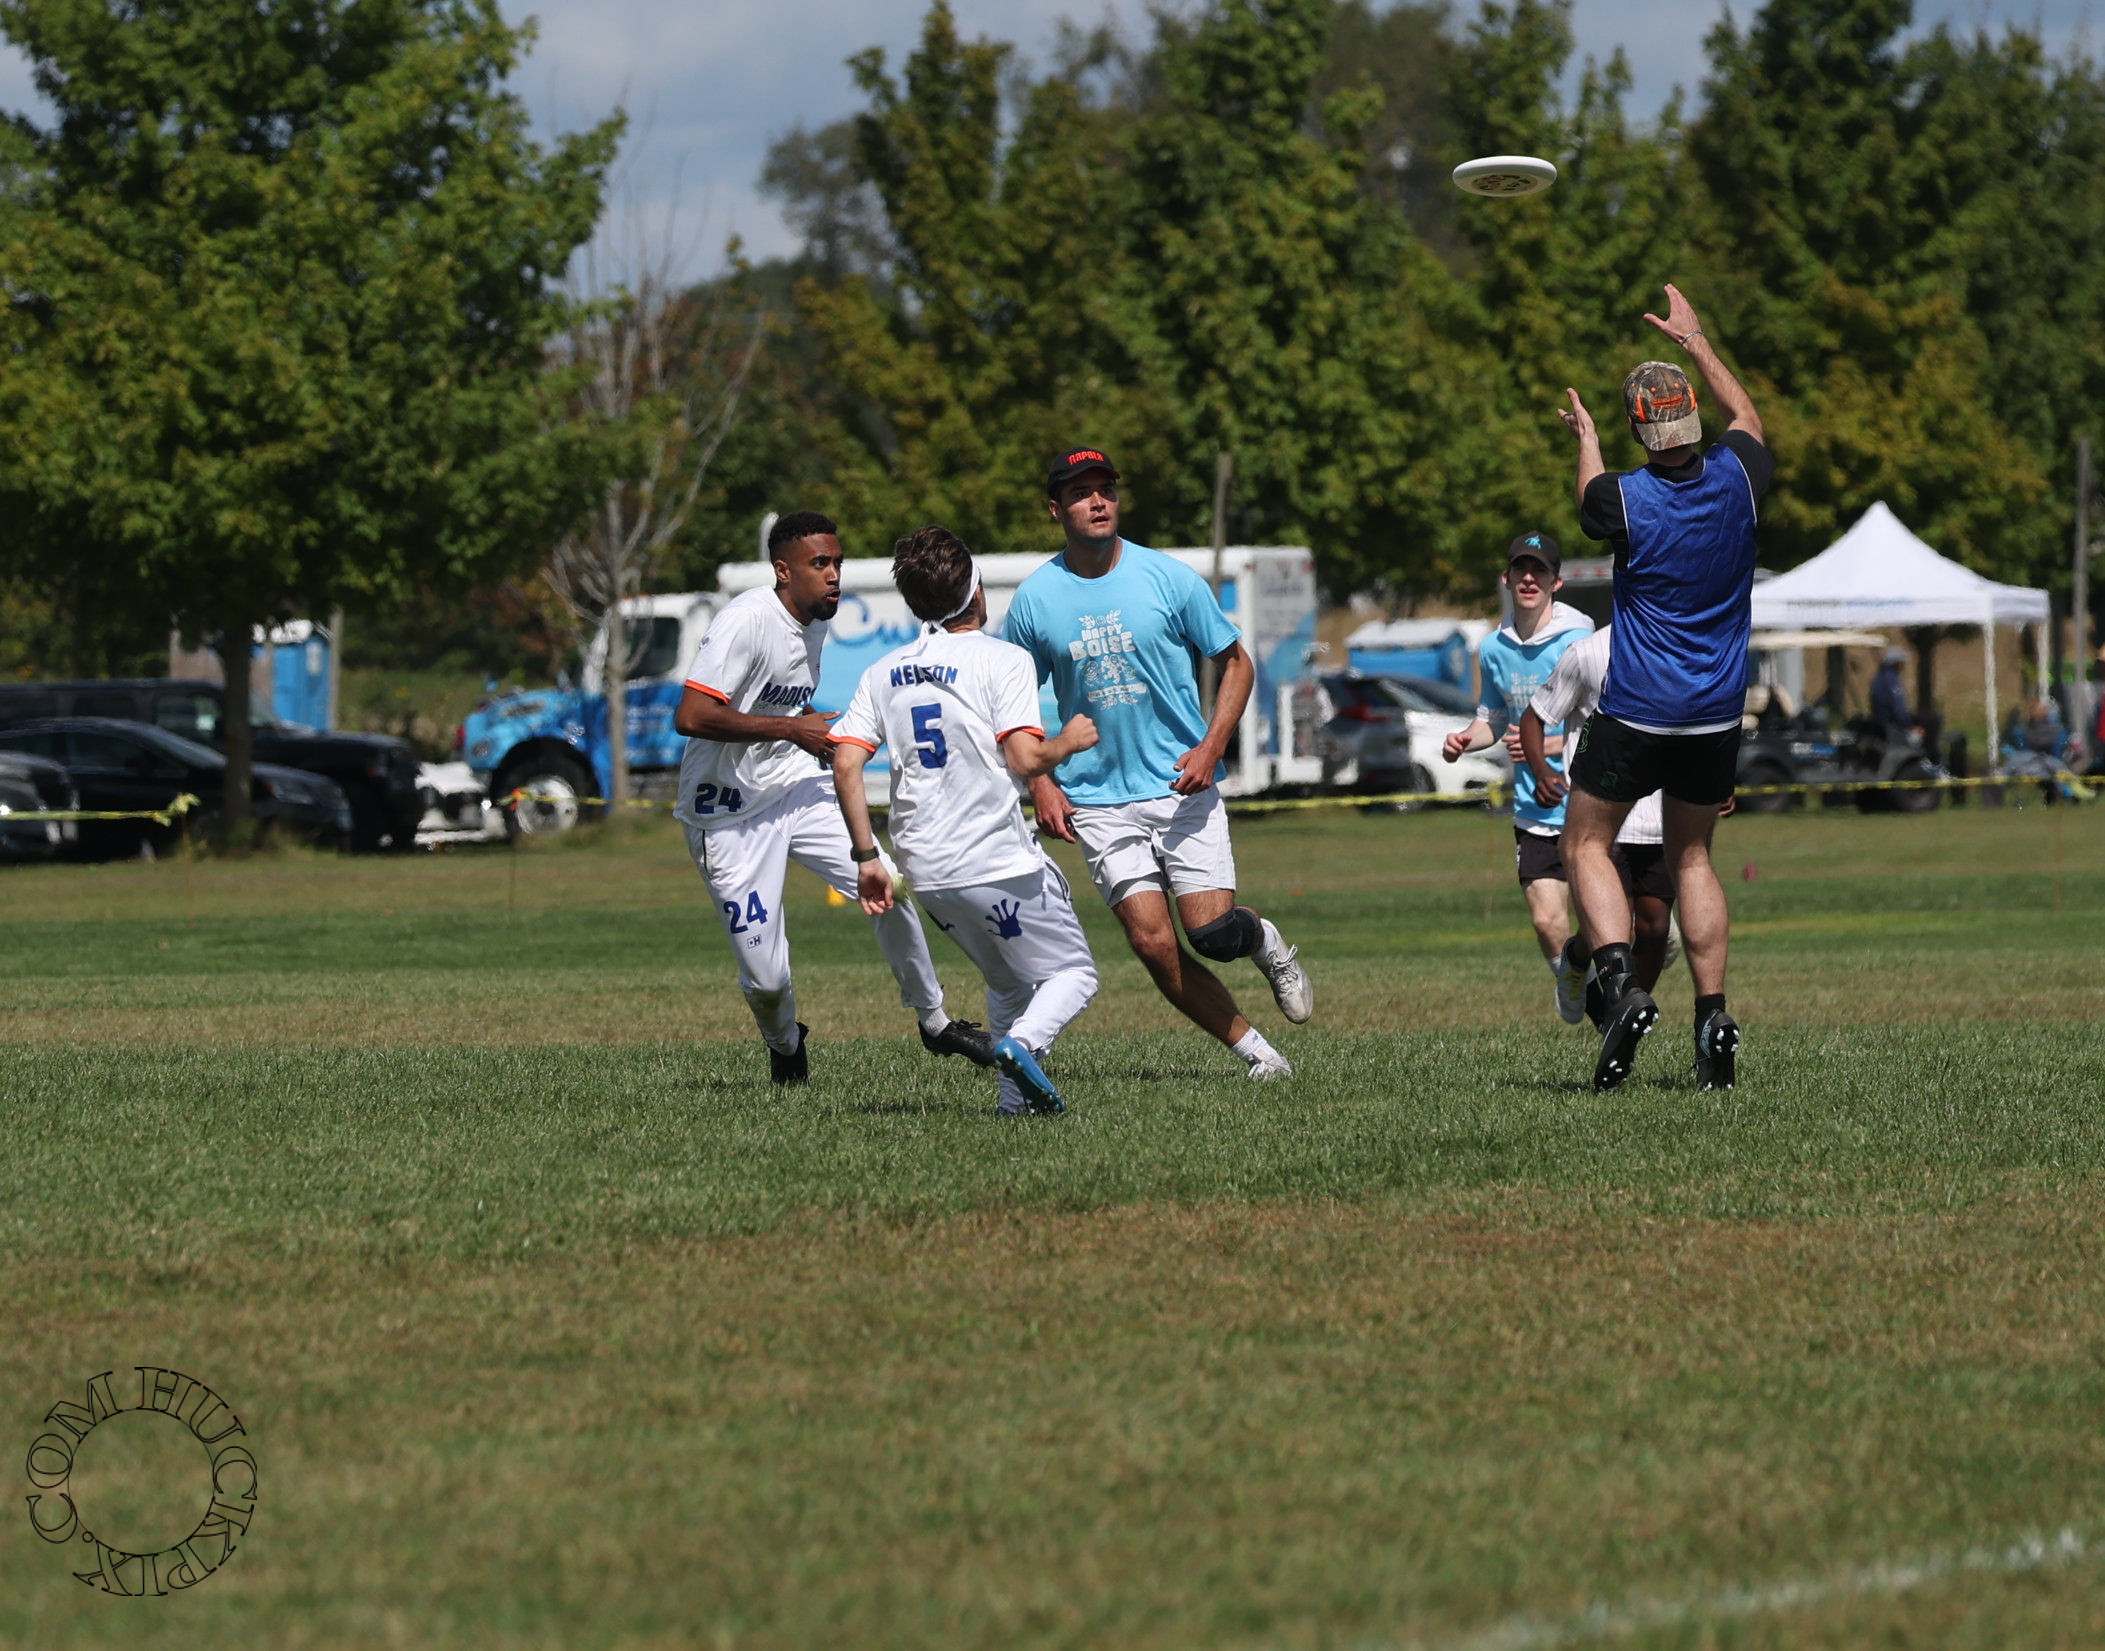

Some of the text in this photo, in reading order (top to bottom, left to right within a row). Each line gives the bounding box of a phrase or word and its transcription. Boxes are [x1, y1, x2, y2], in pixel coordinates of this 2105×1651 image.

[1068, 631, 1136, 661] BOISE
[1081, 623, 1123, 641] HAPPY
[890, 664, 958, 687] NELSON
[911, 702, 948, 769] 5
[695, 783, 742, 814] 24
[723, 890, 768, 934] 24
